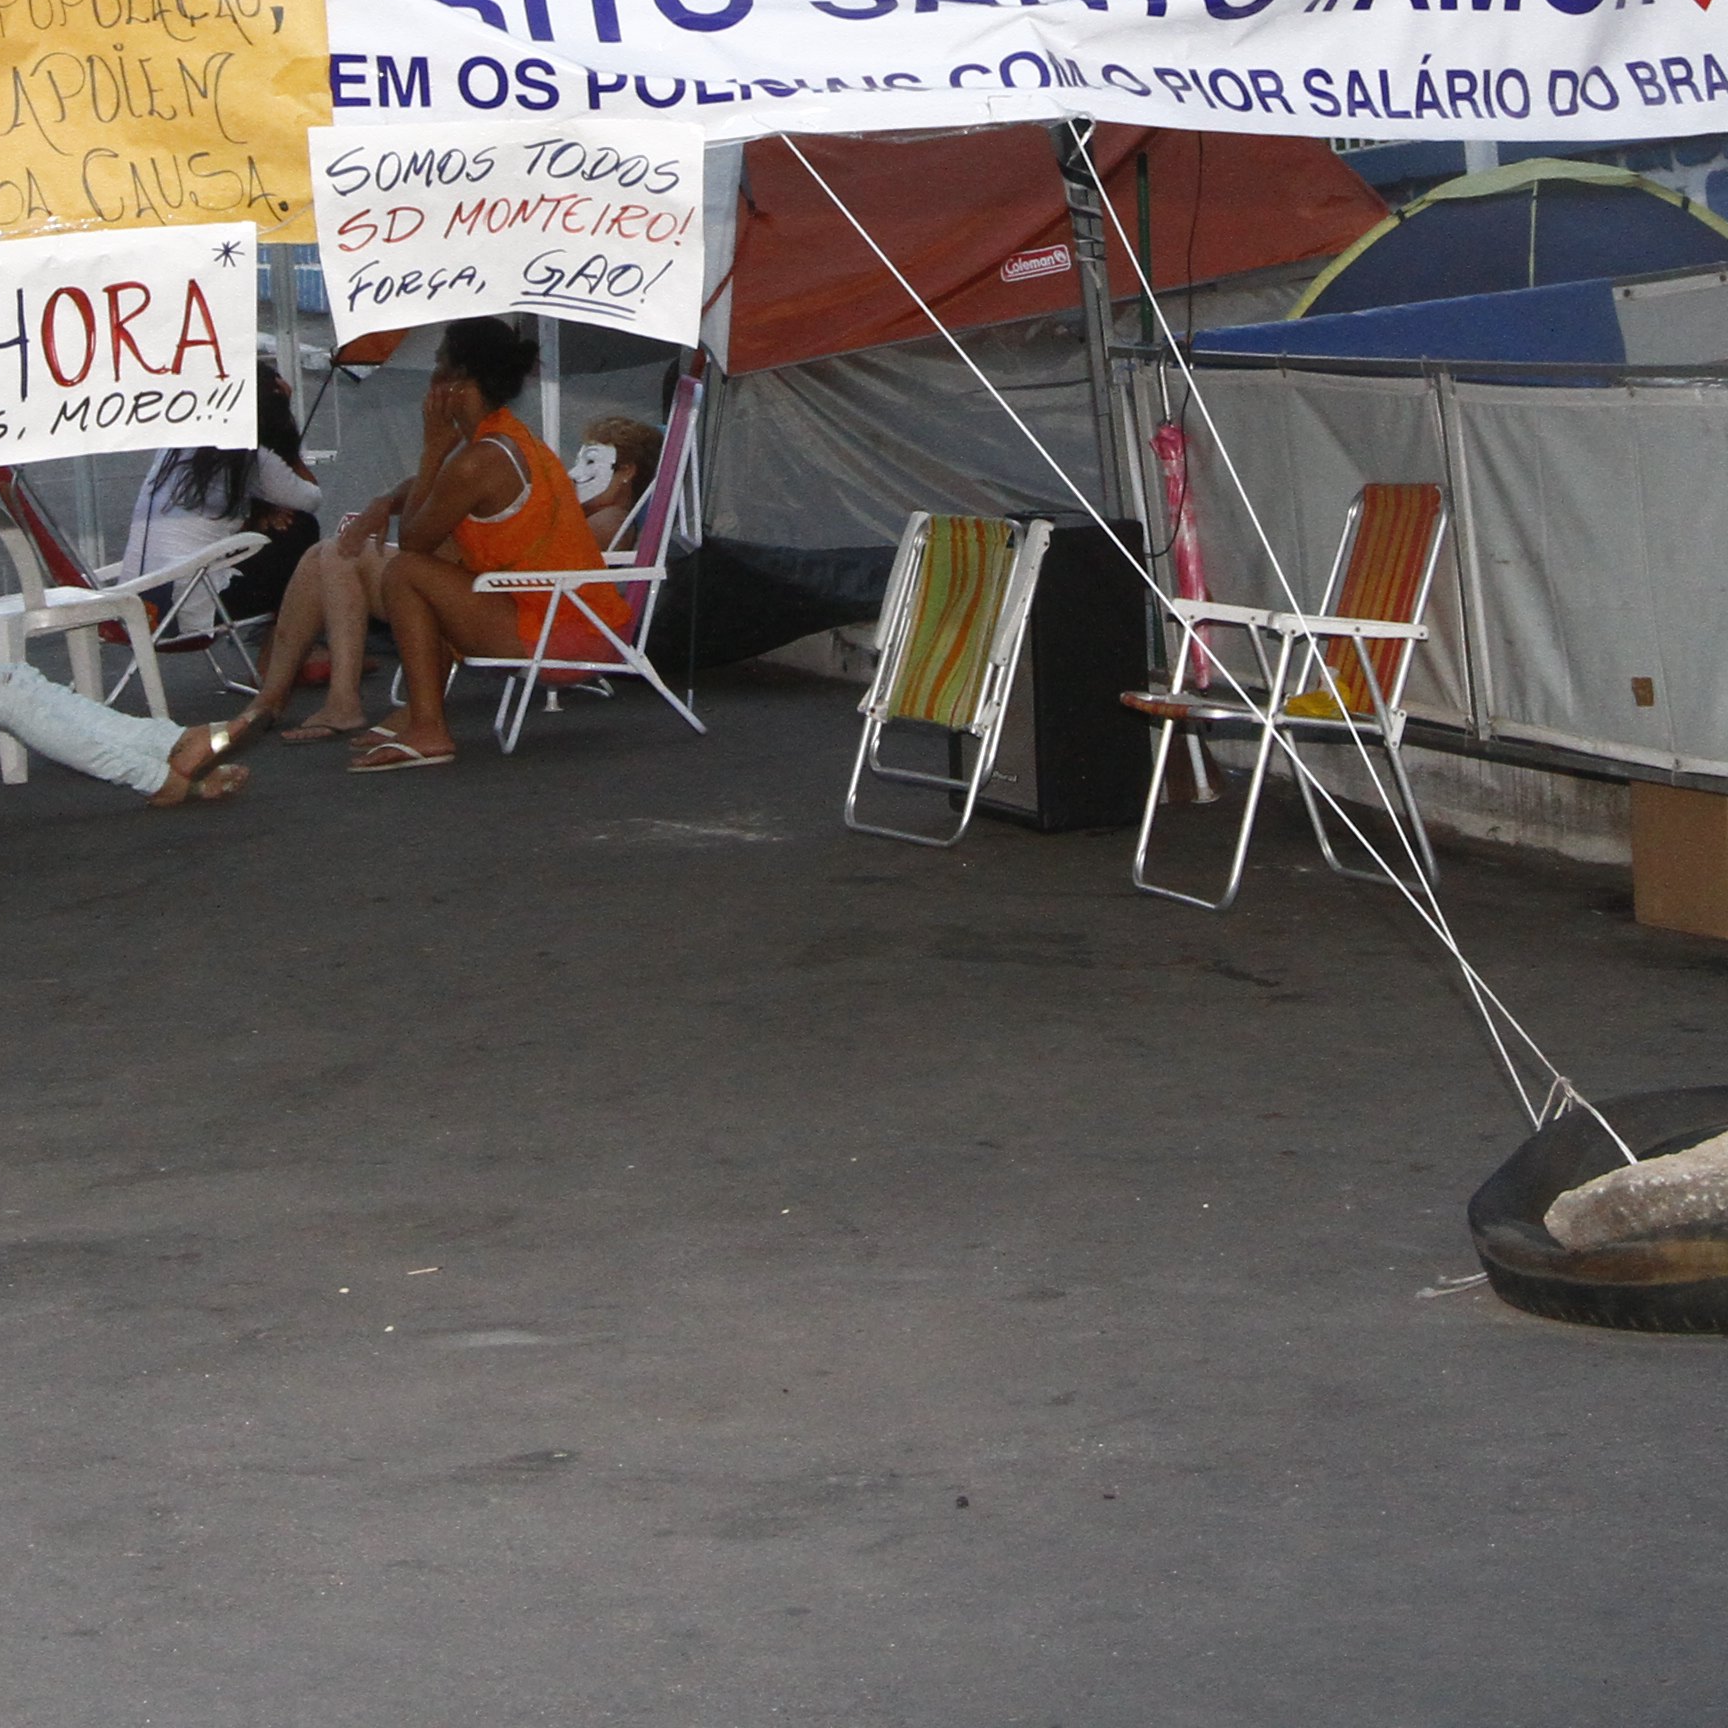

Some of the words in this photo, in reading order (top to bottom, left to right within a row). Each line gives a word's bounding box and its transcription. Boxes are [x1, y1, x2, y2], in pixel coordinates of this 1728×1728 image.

[456, 55, 562, 112] OS
[1154, 64, 1295, 116] PIOR
[1303, 52, 1532, 120] SALÁRIO
[1548, 66, 1621, 116] DO
[325, 145, 495, 197] SOMOS
[524, 138, 681, 194] TODOS
[336, 205, 424, 253] SD
[442, 194, 696, 248] MONTEIRO!
[347, 261, 487, 313] FORÇA,
[1005, 254, 1055, 275] Coleman
